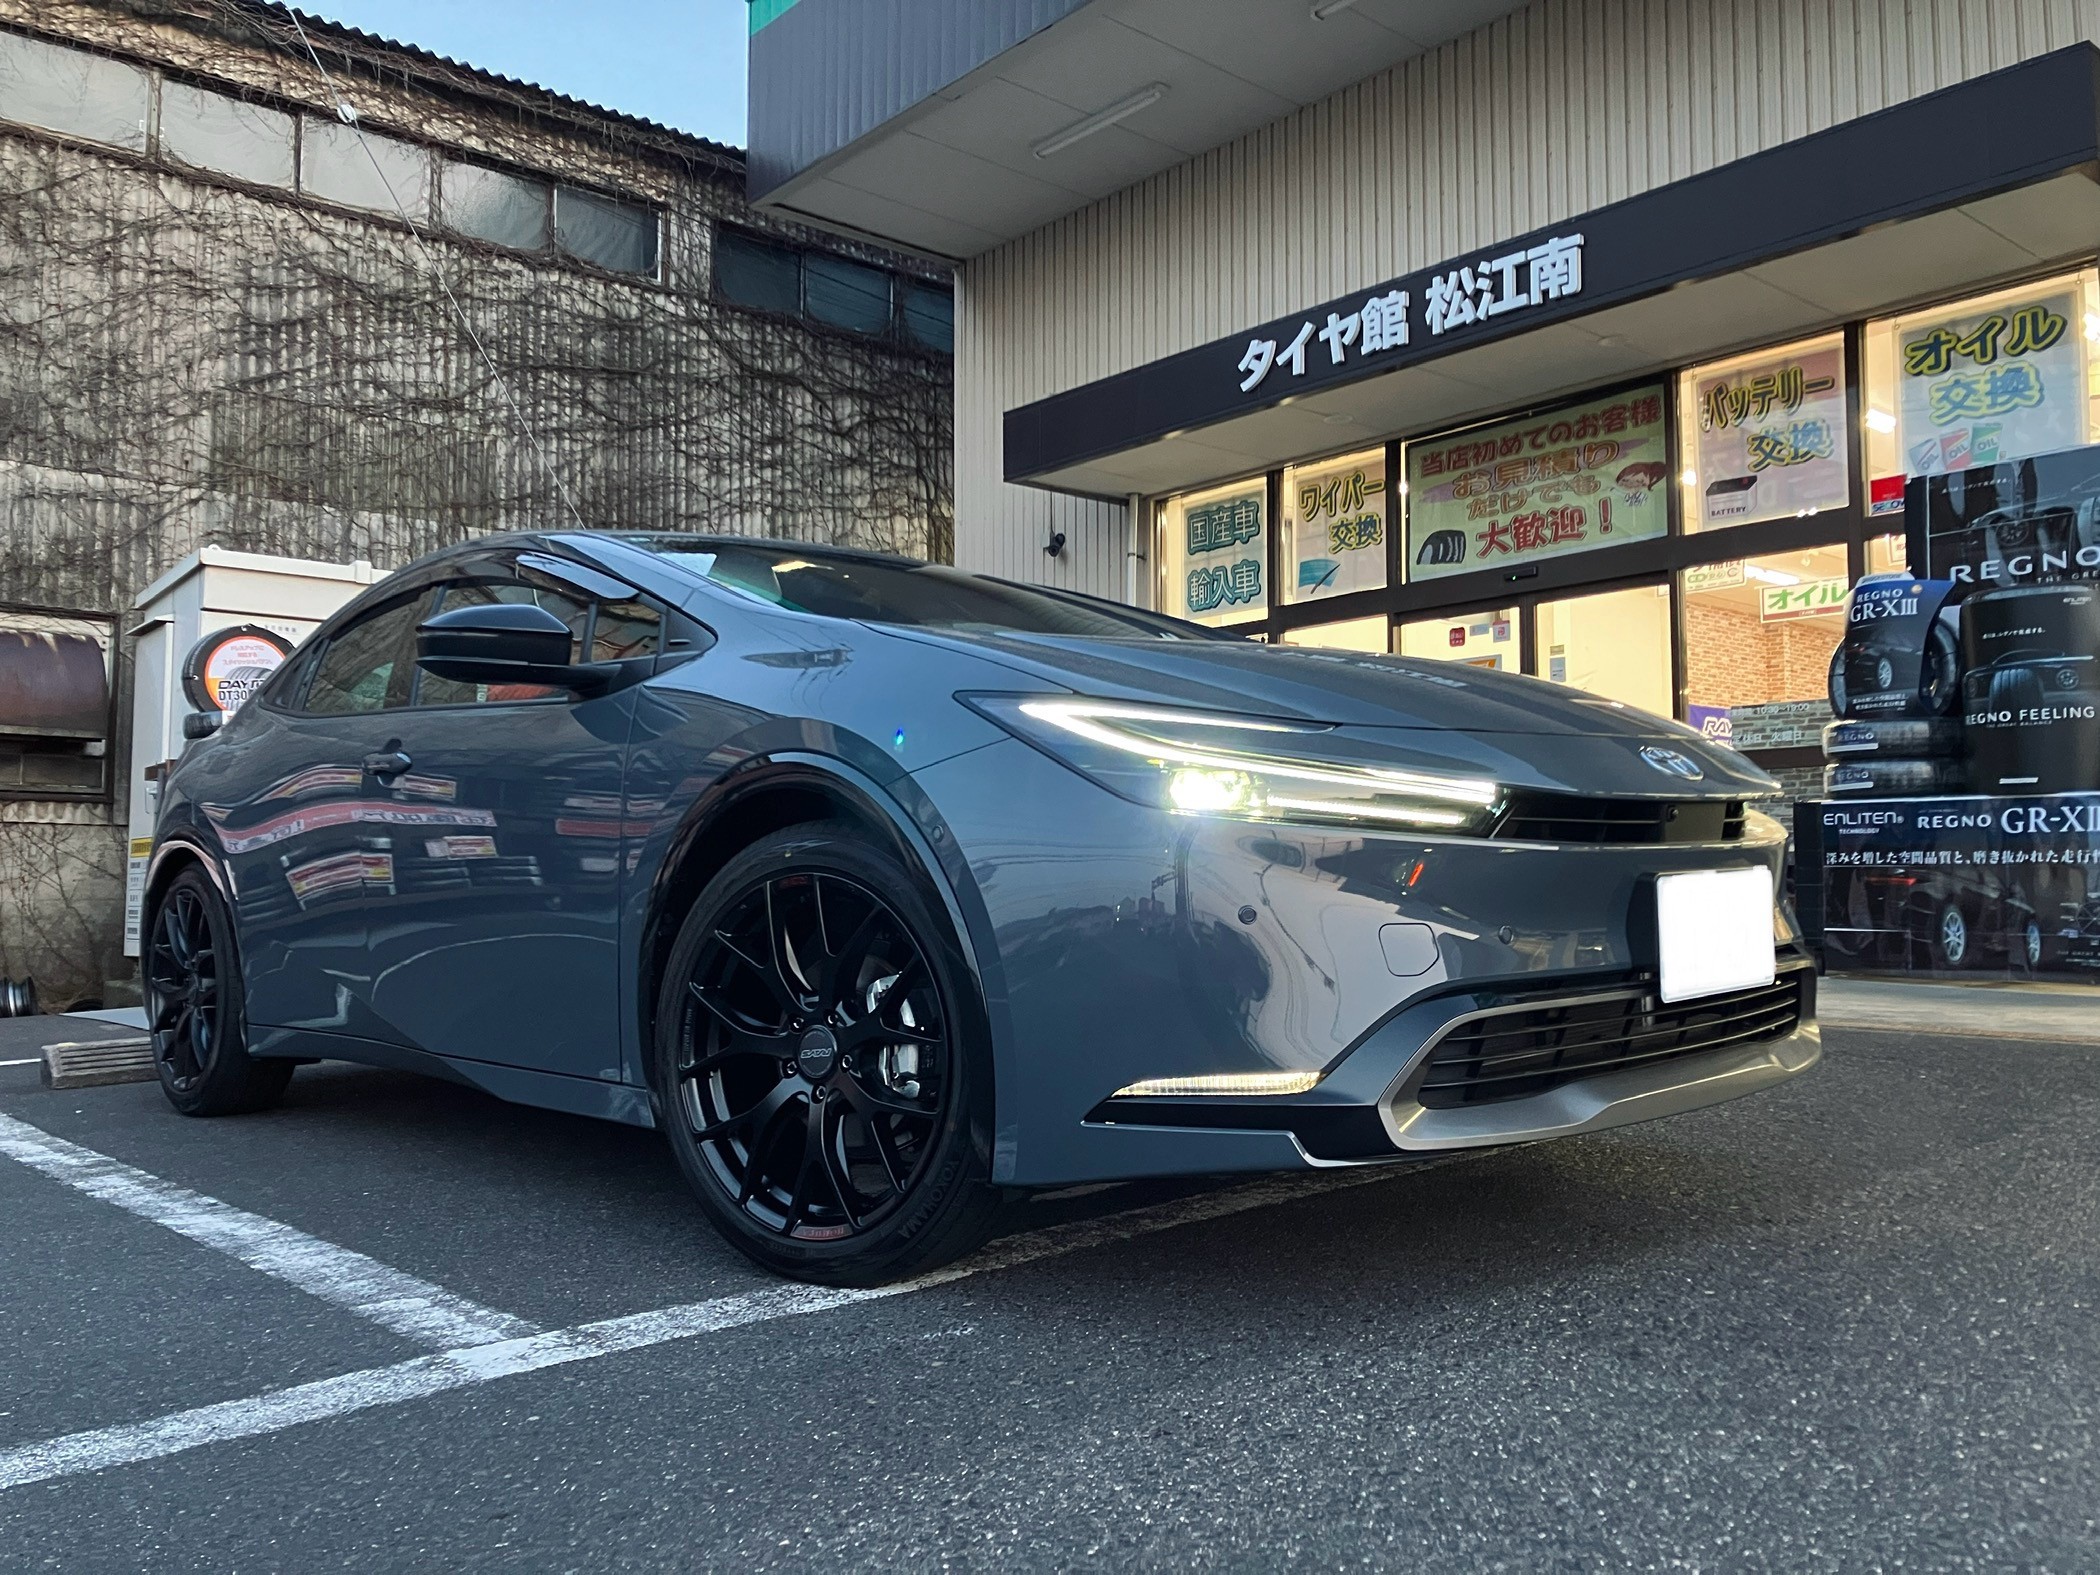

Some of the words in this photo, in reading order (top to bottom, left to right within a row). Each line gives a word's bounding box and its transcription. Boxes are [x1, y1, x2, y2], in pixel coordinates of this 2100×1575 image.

[1238, 290, 1409, 393] タイヤ館
[1425, 233, 1585, 335] 松江南
[1905, 305, 2067, 376] オイル
[1701, 366, 1835, 433] バッテリー
[1929, 360, 2045, 426] 交換
[1420, 394, 1662, 479] 当店初めてのお客様
[1747, 417, 1834, 473] 交換
[1949, 443, 1970, 460] OIL
[1976, 437, 1997, 451] OIL
[1453, 440, 1620, 499] お見積り
[1921, 450, 1940, 471] OIL
[1299, 472, 1384, 521] ワイパー
[1467, 475, 1601, 520] だけでも
[1711, 506, 1746, 517] BATTERY
[1872, 499, 1905, 513] SECO
[1188, 501, 1260, 554] 国産車
[1329, 513, 1382, 554] 交換
[1950, 546, 2100, 582] REGNO
[1187, 559, 1261, 612] 輸入車
[1768, 583, 1848, 609] オイル
[1856, 588, 1903, 603] REGNO
[218, 690, 248, 701] DT30
[1965, 710, 2012, 725] REGNO
[2019, 706, 2095, 721] FEELING
[1839, 827, 1881, 835] TECHNOLOGY
[1917, 815, 1992, 828] REGNO
